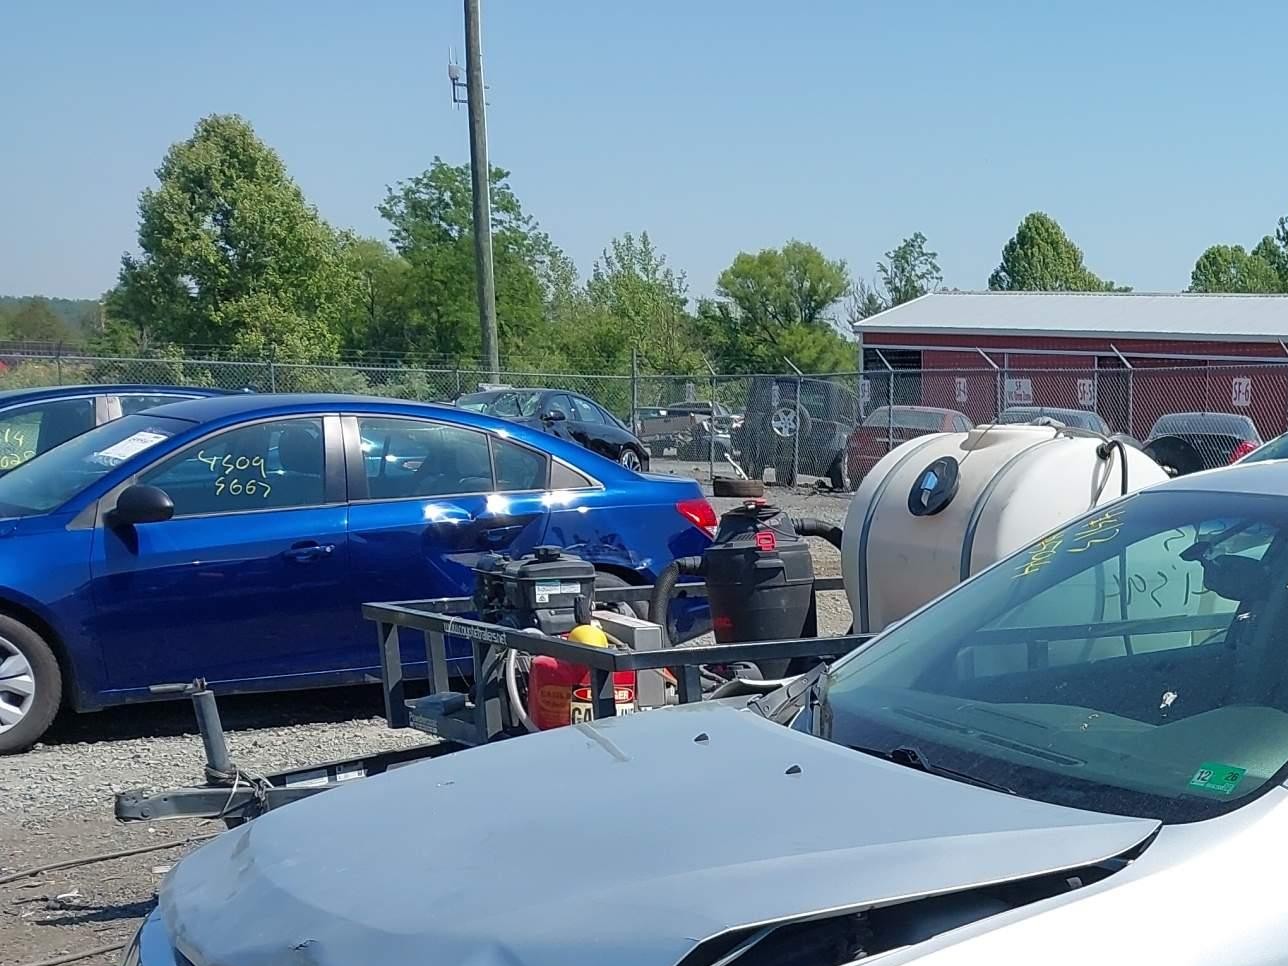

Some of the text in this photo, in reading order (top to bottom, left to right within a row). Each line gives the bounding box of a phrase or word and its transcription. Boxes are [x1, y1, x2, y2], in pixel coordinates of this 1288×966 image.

[198, 450, 267, 479] 4509
[1197, 770, 1240, 782] 12 26
